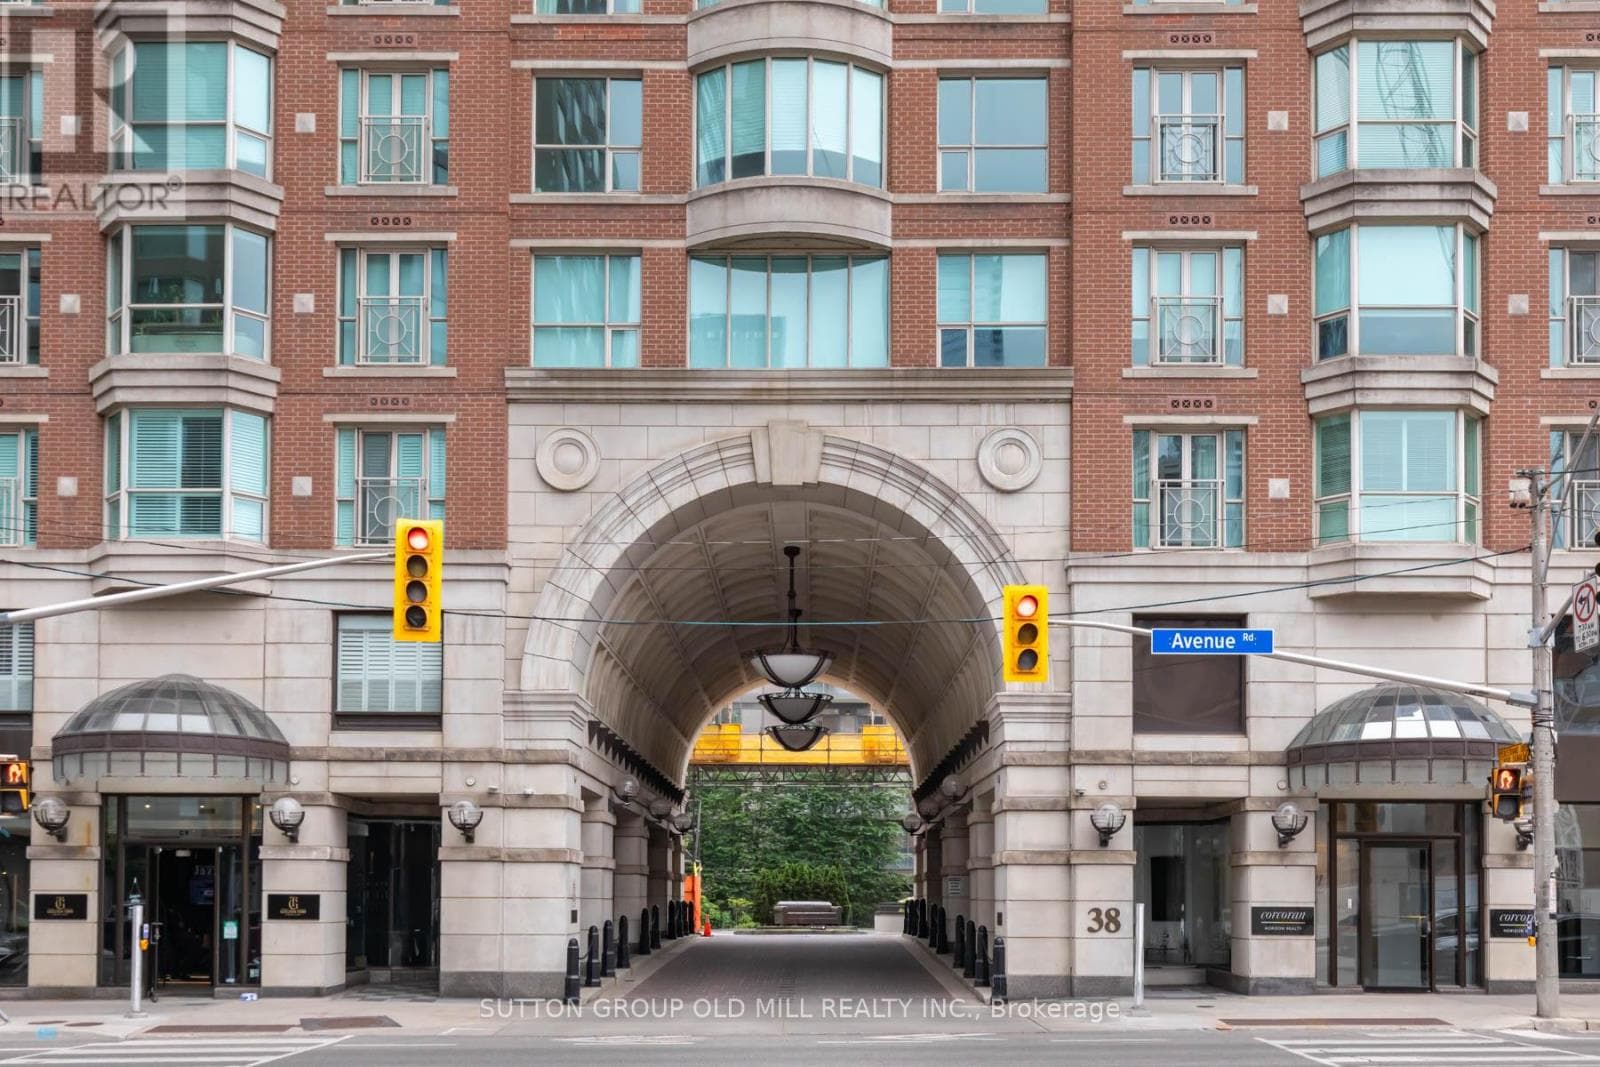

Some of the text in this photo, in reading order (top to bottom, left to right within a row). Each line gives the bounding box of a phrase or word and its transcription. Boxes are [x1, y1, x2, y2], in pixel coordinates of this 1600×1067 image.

[1171, 632, 1236, 649] Avenue
[1087, 907, 1121, 933] 38
[1260, 911, 1306, 920] corcoran
